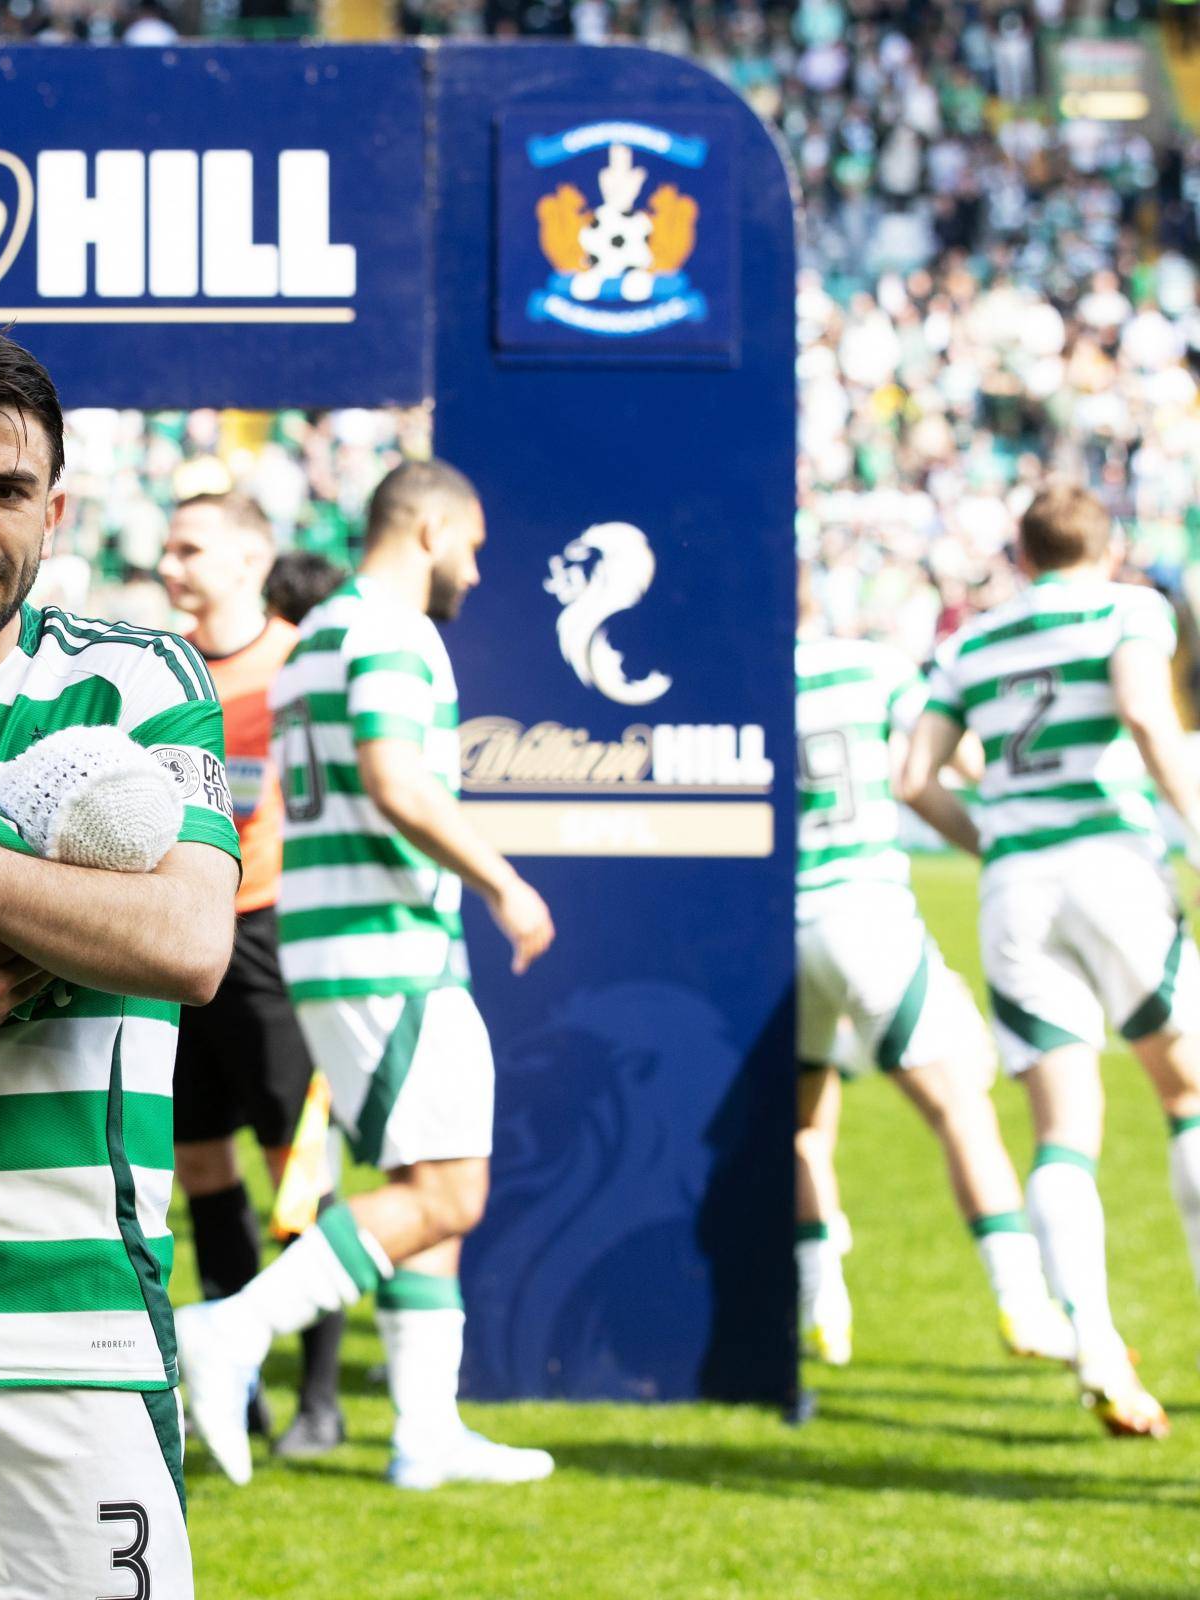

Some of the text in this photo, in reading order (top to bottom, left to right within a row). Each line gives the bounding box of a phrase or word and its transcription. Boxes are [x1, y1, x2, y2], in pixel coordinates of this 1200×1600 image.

[36, 149, 356, 298] HILL
[653, 724, 774, 785] HILL
[1000, 668, 1066, 777] 2
[91, 1340, 136, 1349] AEROREADY
[97, 1500, 152, 1600] 3
